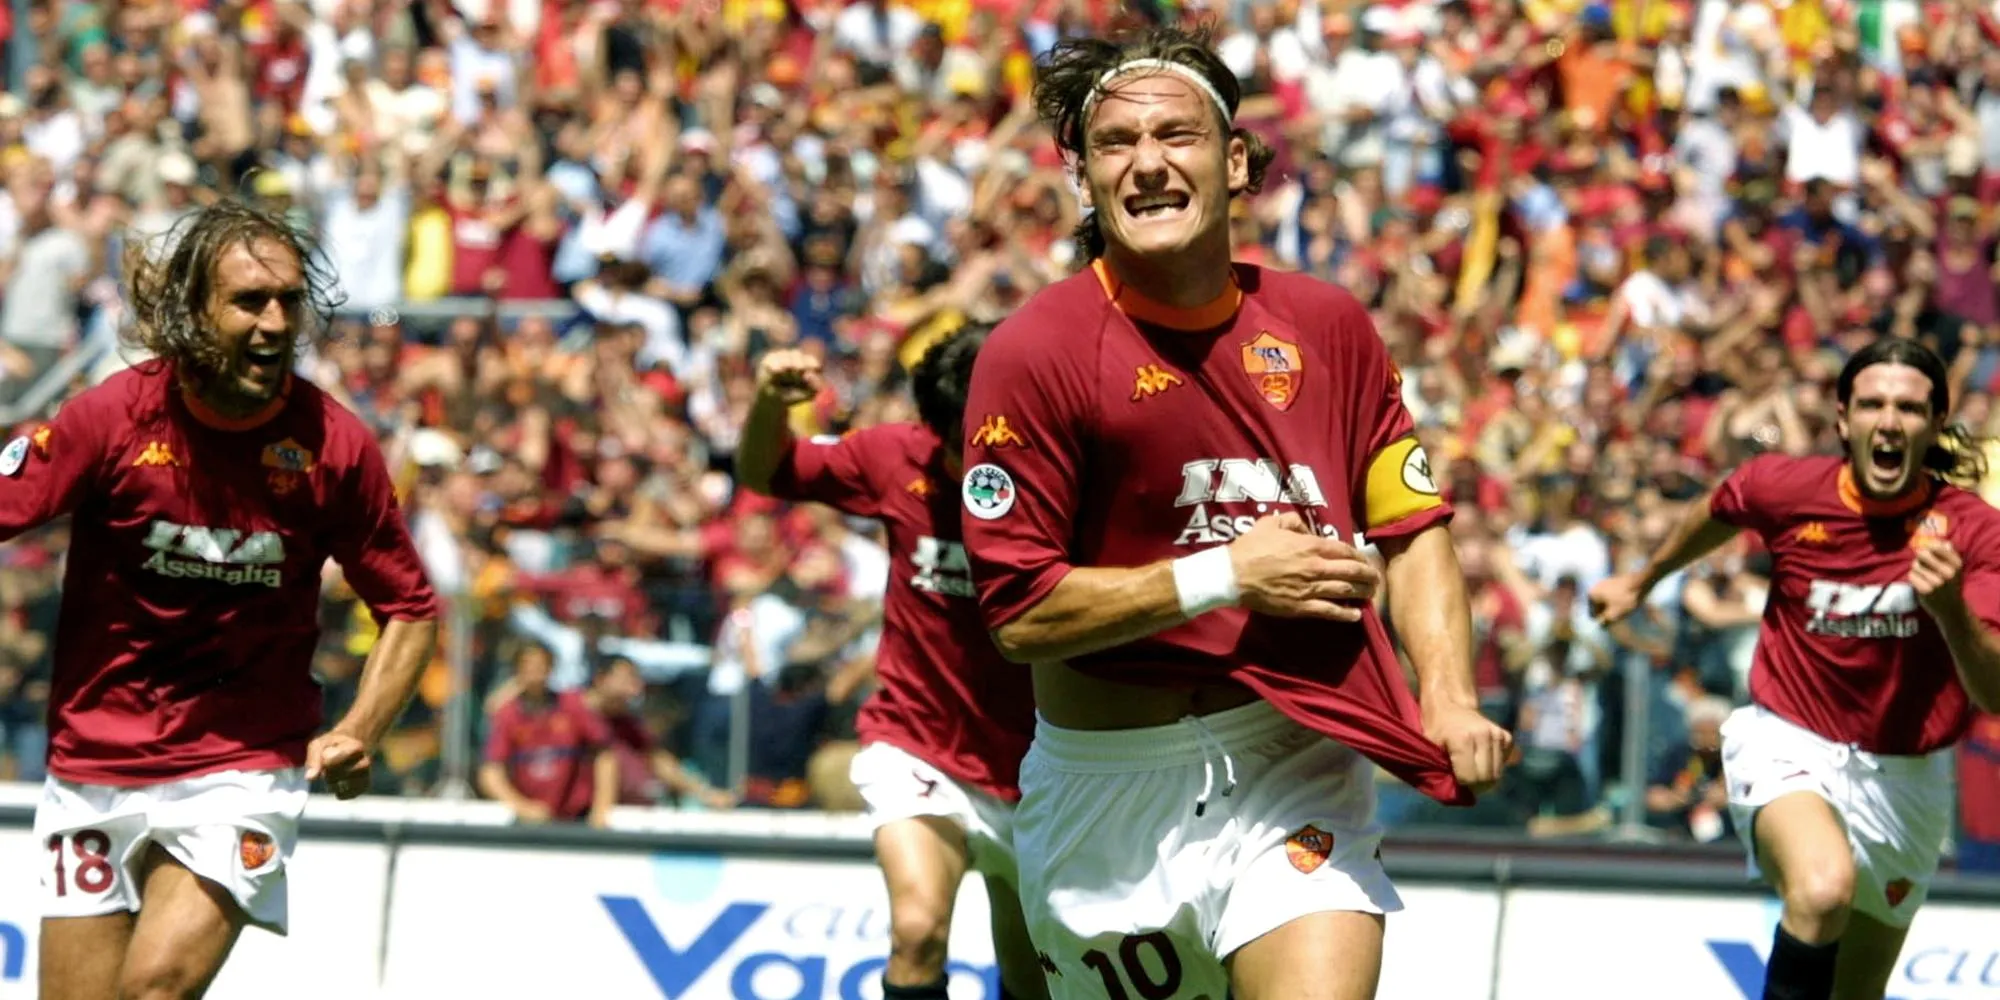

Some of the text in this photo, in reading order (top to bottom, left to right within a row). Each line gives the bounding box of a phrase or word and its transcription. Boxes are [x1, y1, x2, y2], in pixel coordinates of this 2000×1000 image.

[1174, 458, 1328, 508] INA
[142, 519, 286, 564] INA
[140, 551, 283, 588] Assitalia
[48, 829, 114, 897] 18
[1081, 931, 1182, 1000] 10
